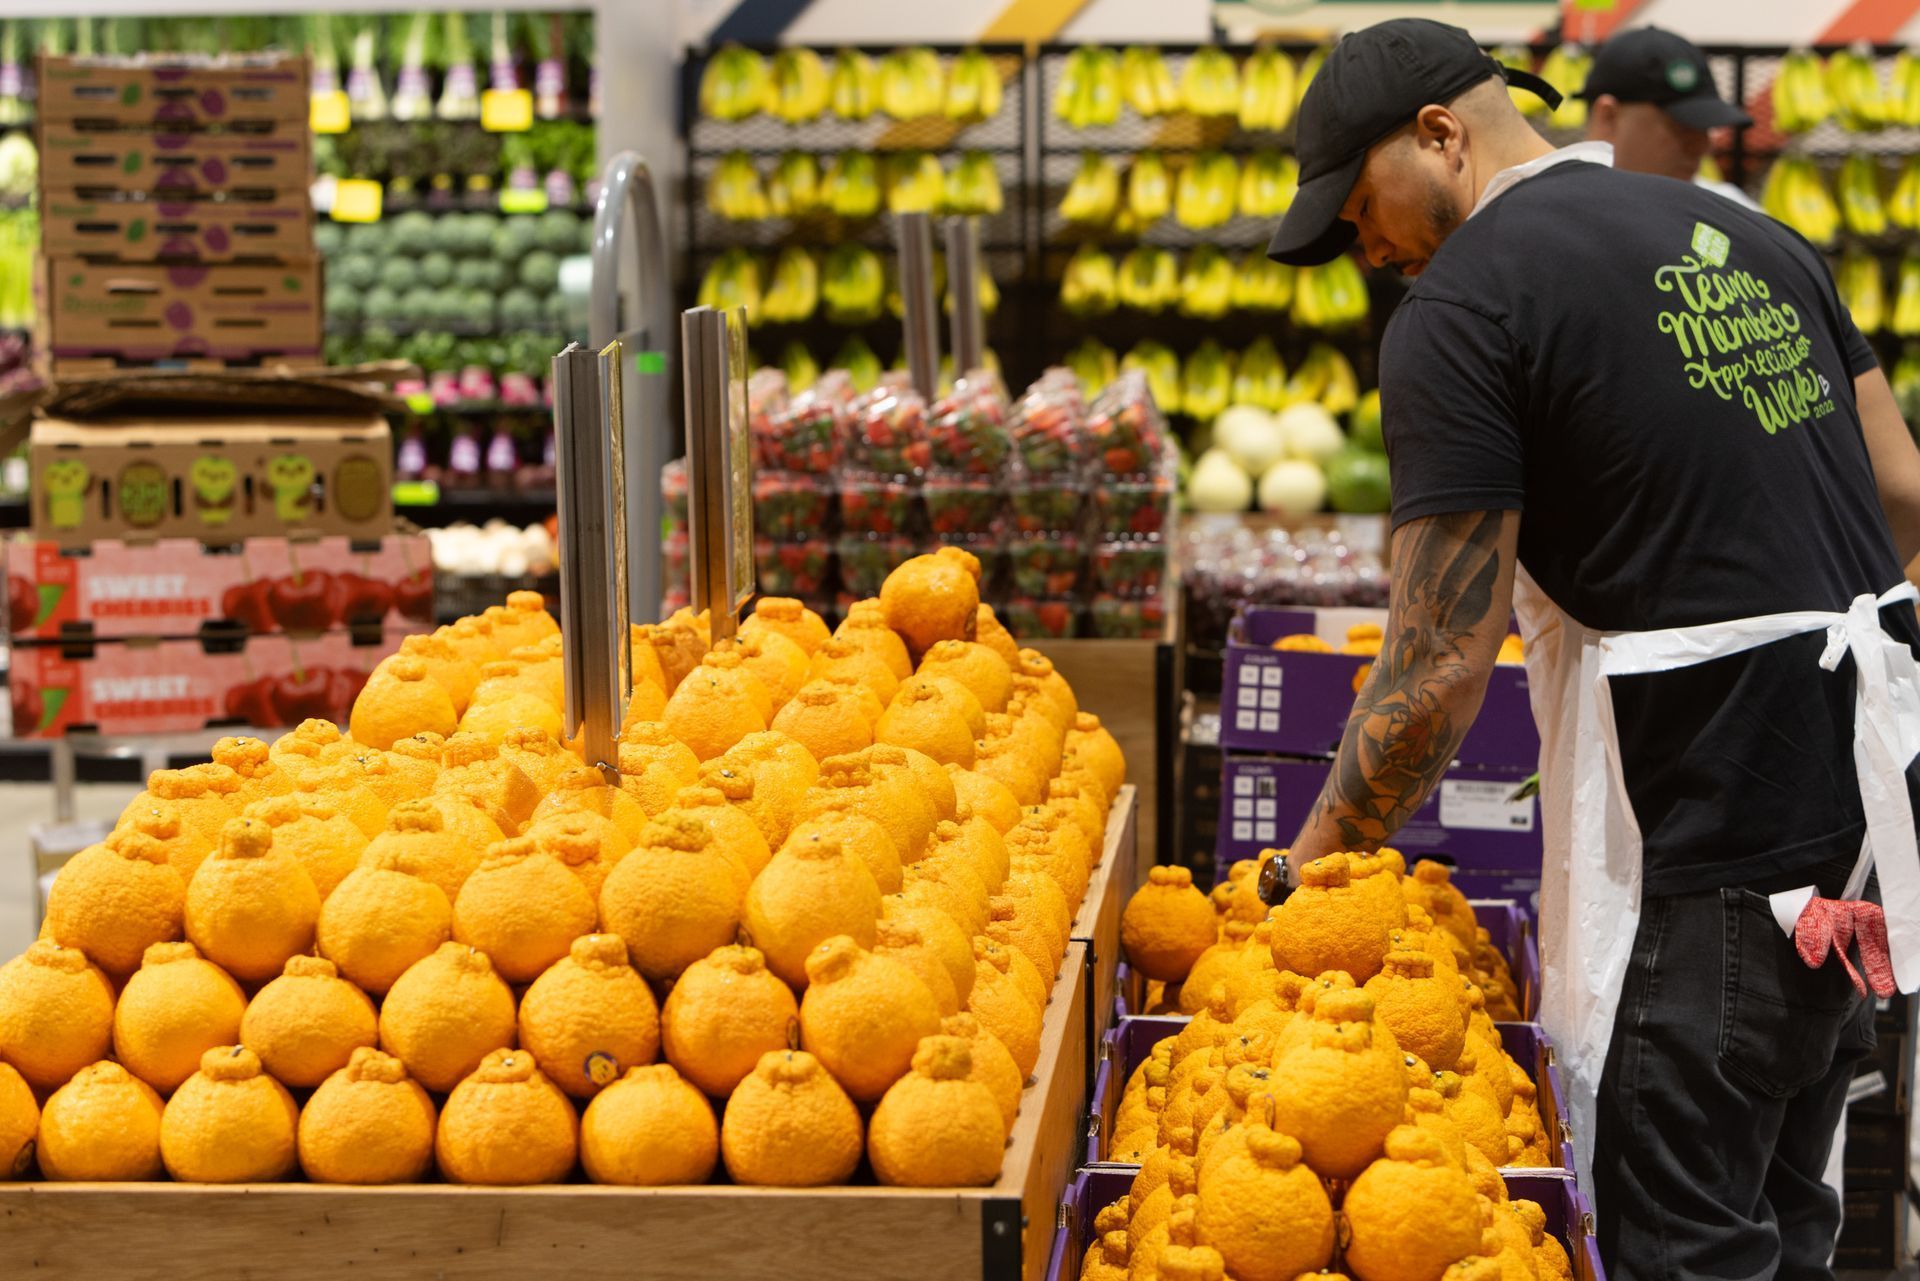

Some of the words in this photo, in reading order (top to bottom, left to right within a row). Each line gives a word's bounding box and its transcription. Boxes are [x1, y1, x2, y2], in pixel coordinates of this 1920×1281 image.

[1654, 255, 1771, 314] Team
[1657, 302, 1801, 359] Member
[1683, 334, 1812, 401] Appreciation
[1743, 367, 1820, 435] Week
[1813, 399, 1835, 419] 2022
[90, 576, 185, 598] SWEET
[93, 677, 188, 700] SWEET
